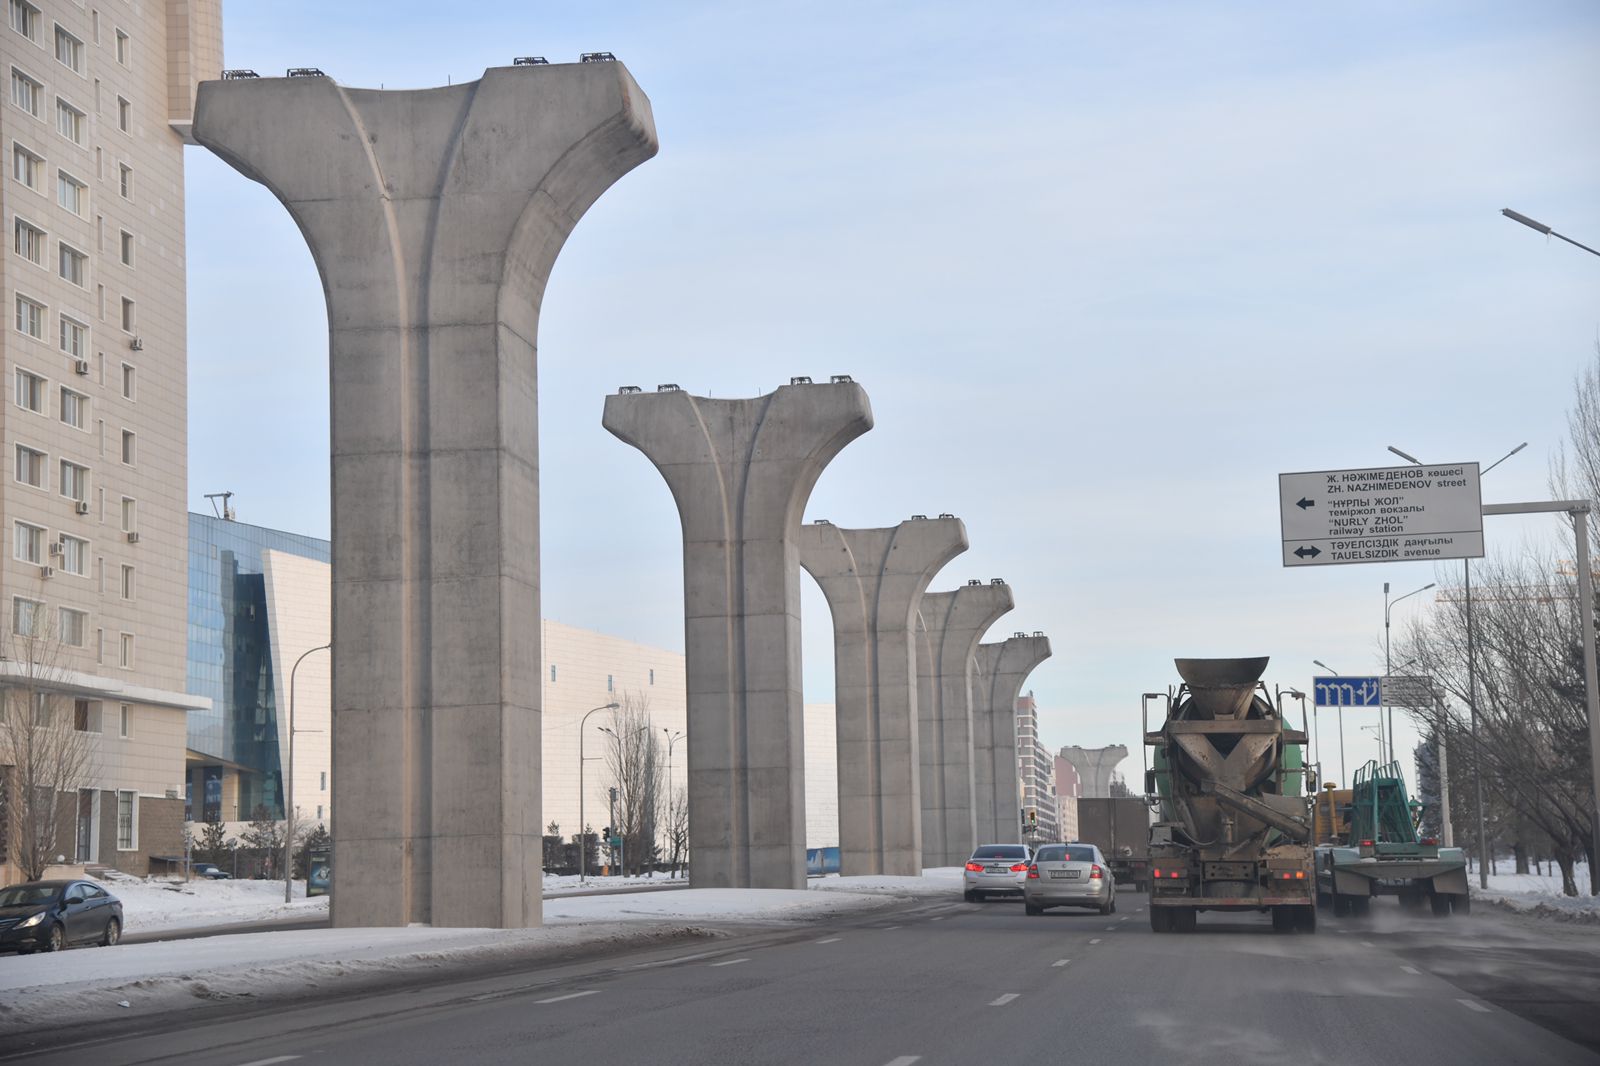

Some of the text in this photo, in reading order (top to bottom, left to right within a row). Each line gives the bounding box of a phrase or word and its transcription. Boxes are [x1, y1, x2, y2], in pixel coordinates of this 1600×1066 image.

[1327, 467, 1464, 483] Ж. НӘЖІМЕДЕНОВ көшесі
[1327, 478, 1466, 494] ZH. NAZHIMEDENOV street
[1329, 505, 1425, 517] теміржол вокзалы
[1329, 524, 1404, 536] railway station
[1331, 536, 1453, 550] ТӘУЕЛСІЗДІК даңғылы
[1331, 547, 1441, 560] TAUELSIZDIK avenue
